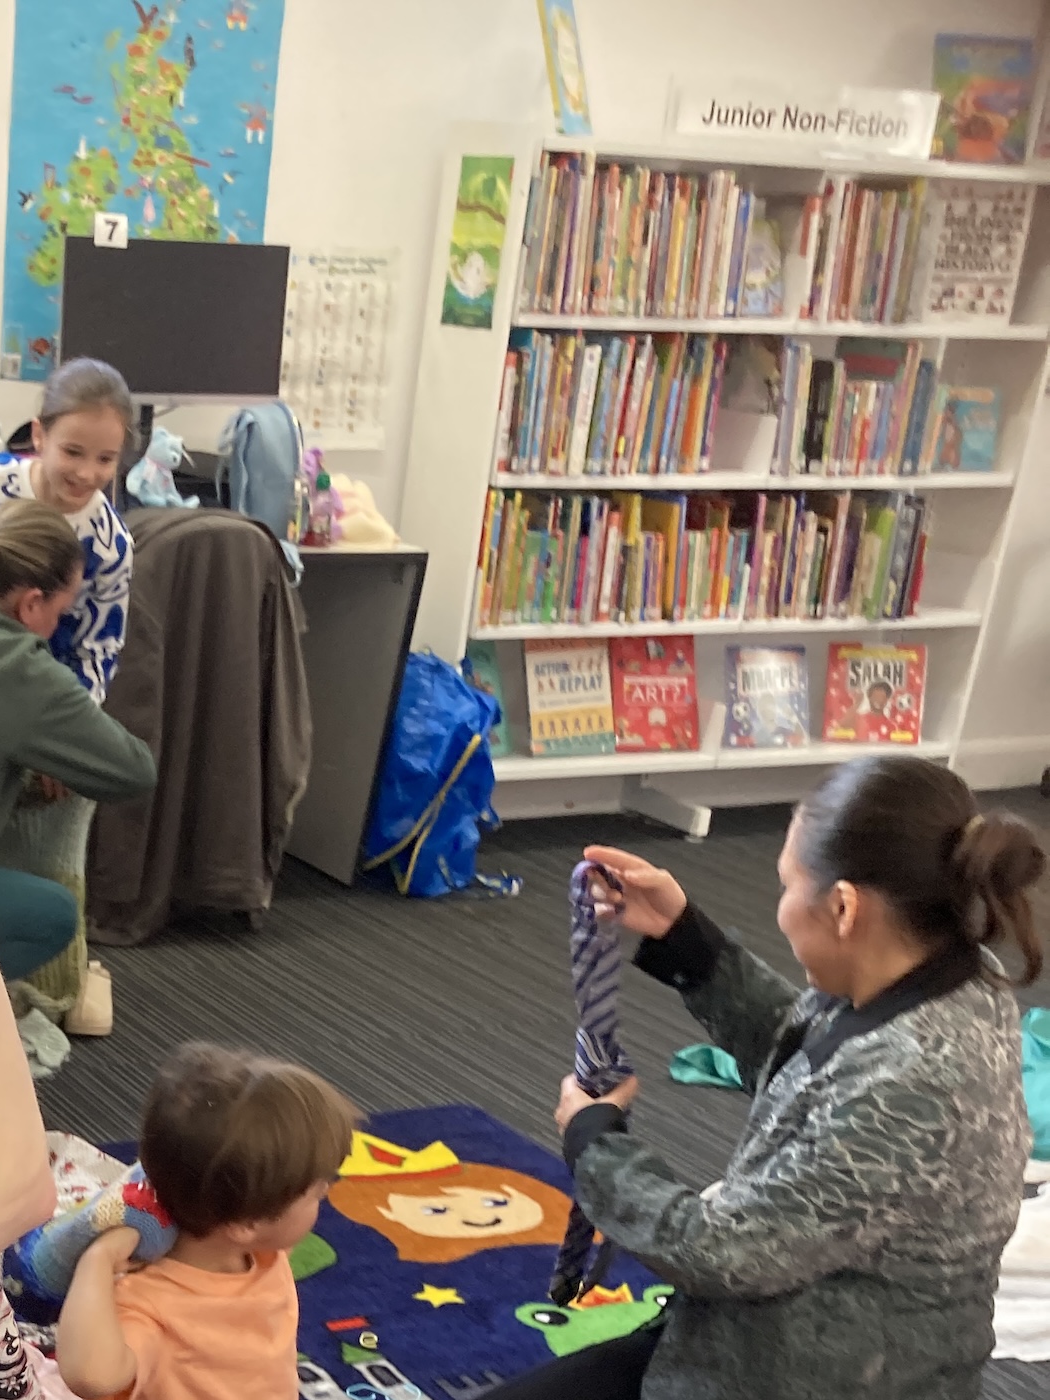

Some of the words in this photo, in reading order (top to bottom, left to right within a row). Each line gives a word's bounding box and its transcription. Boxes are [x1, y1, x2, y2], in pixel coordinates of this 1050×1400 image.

[702, 98, 776, 130] Junior
[782, 104, 908, 138] Non-Fiction
[104, 219, 118, 241] 7
[559, 674, 603, 694] REPLAY
[850, 659, 906, 687] SALAH
[631, 684, 681, 703] ART?
